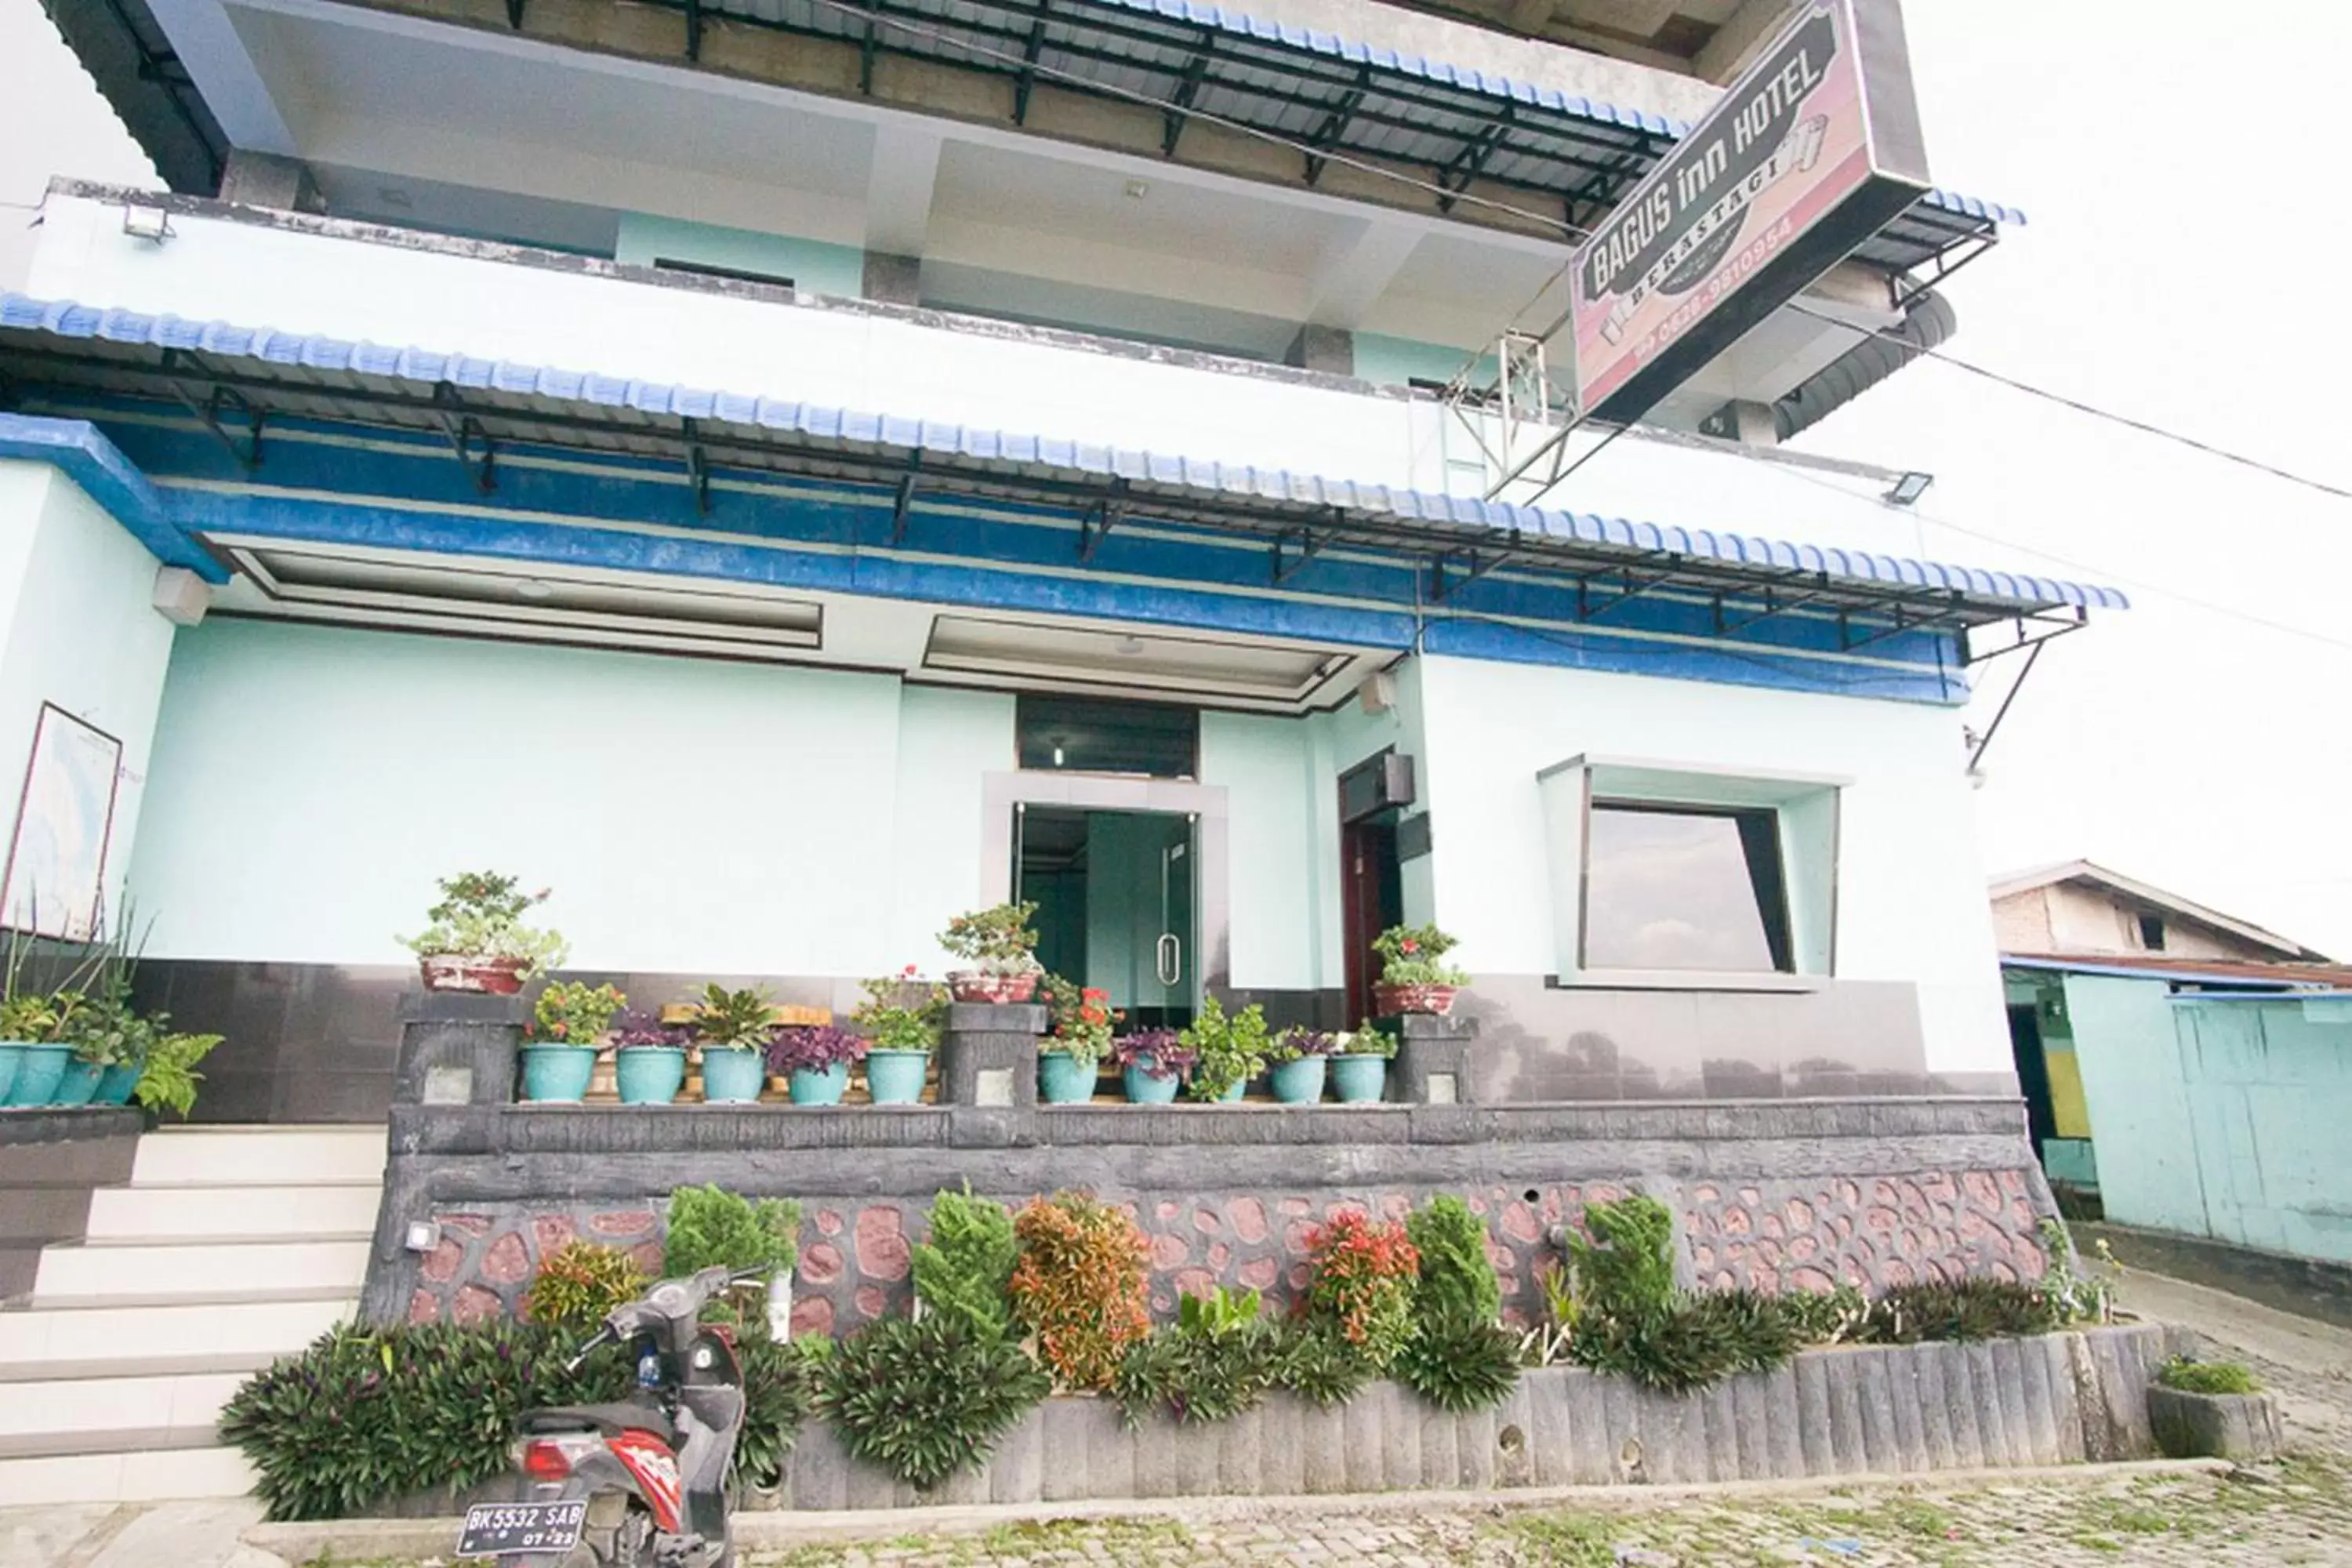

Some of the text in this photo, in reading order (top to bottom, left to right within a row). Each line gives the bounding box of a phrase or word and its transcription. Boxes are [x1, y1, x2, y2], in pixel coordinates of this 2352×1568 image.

[1592, 181, 1671, 293] BAGUS
[1732, 49, 1821, 155] HOTEL
[1631, 158, 1777, 306] BERASTAGI
[545, 1505, 581, 1526] SAB
